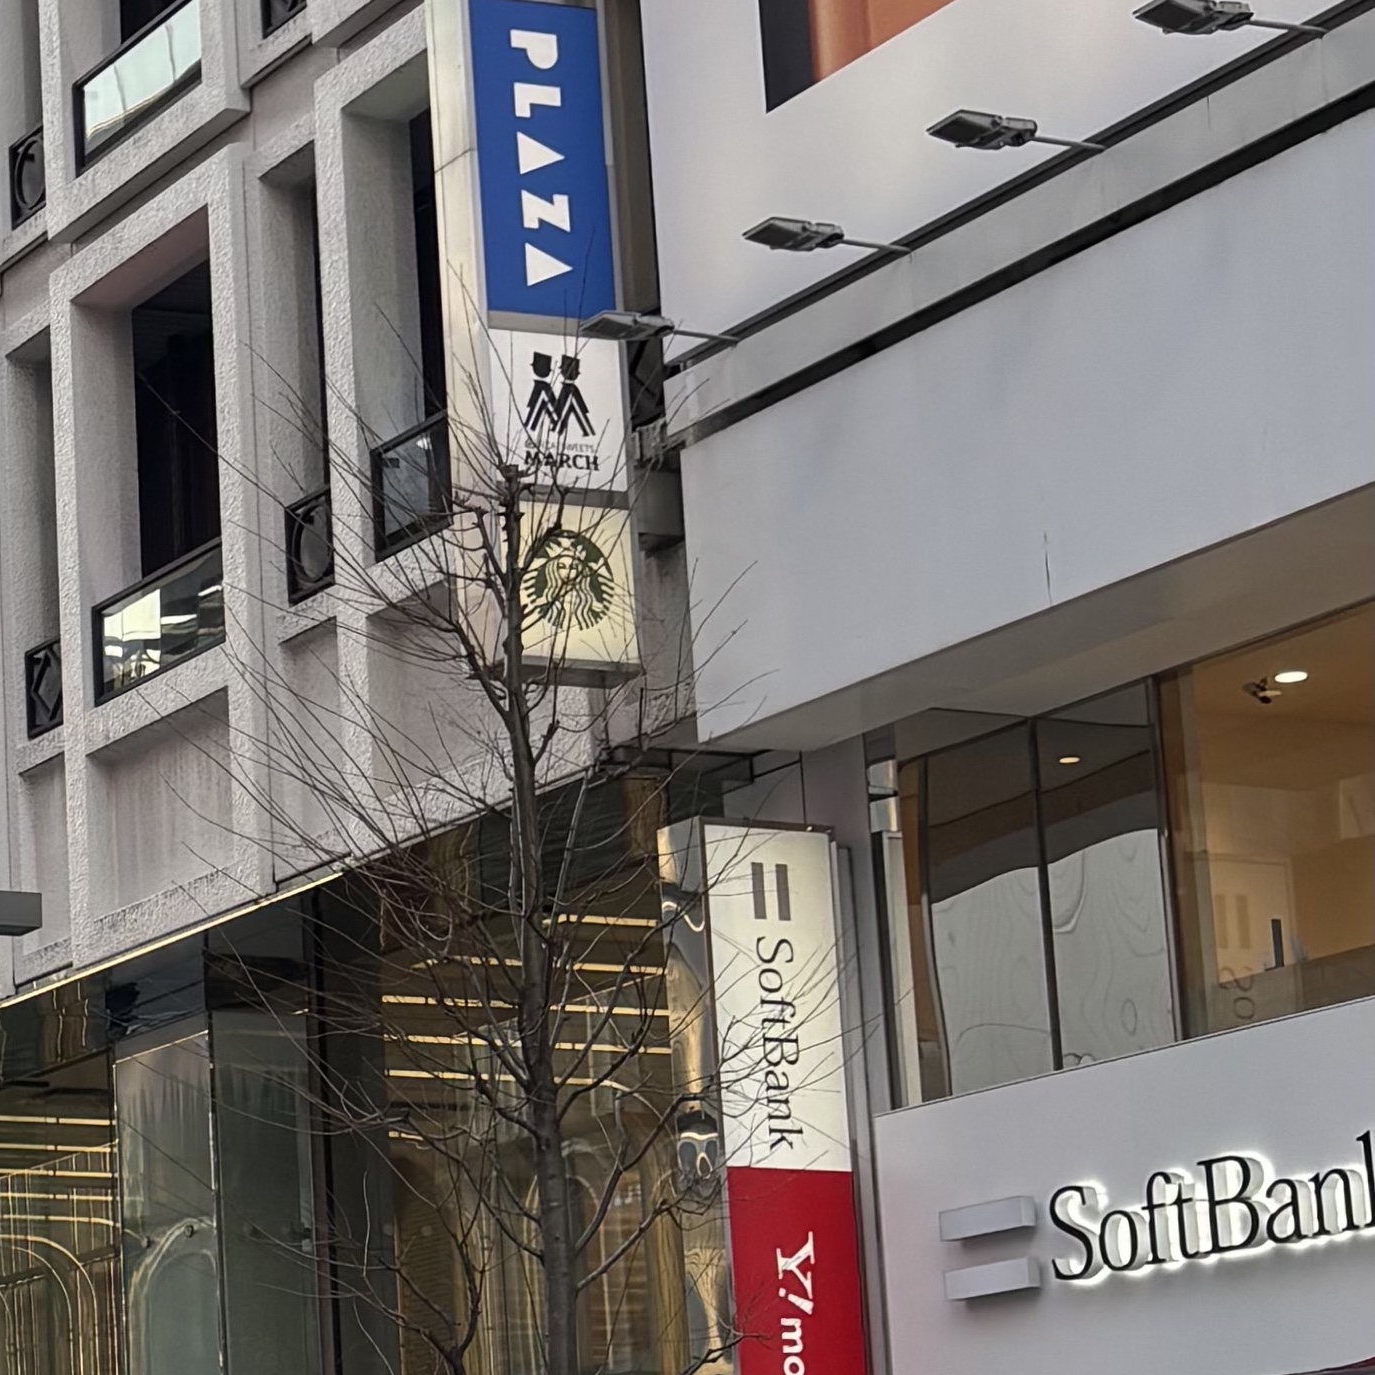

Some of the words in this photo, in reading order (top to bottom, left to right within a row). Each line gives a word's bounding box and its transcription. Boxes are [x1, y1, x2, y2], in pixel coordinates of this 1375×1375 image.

[510, 30, 573, 287] PLAZA
[524, 450, 601, 472] MARCH
[752, 935, 804, 1152] SoftBank
